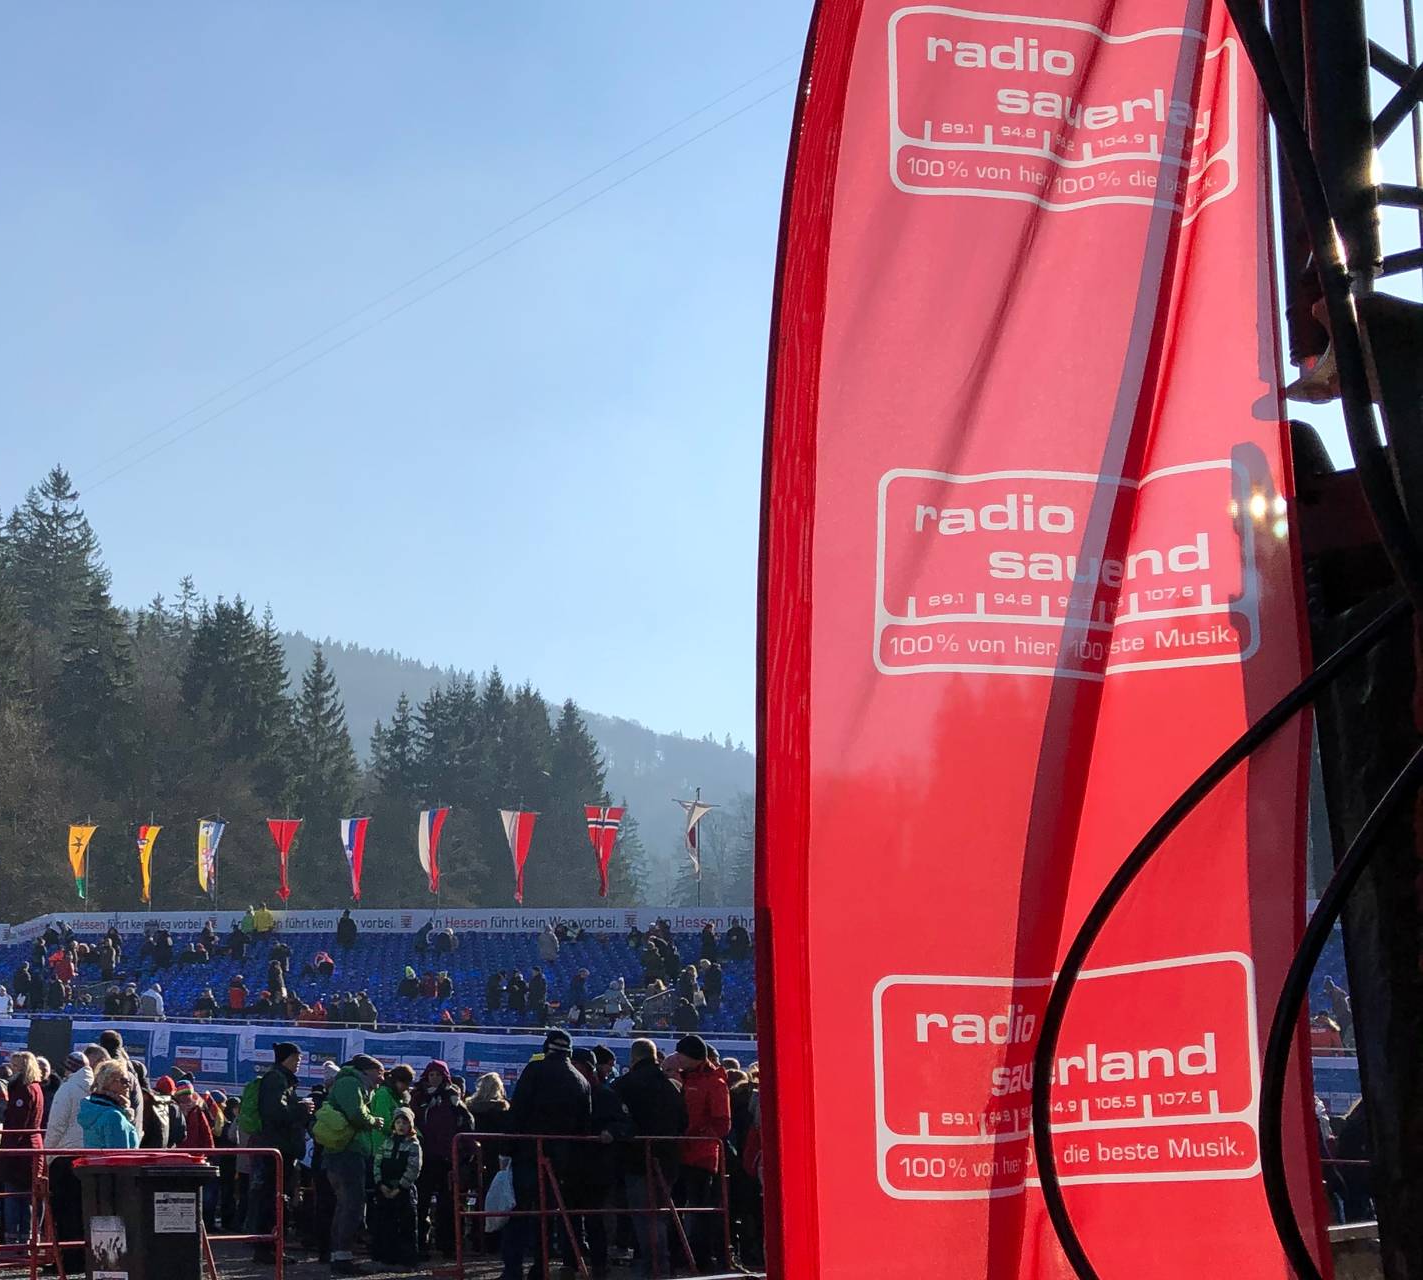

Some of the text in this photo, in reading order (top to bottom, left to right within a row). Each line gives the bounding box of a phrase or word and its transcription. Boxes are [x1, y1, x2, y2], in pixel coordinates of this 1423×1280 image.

[927, 36, 1075, 77] radio
[941, 122, 973, 135] 89.1
[1000, 126, 1037, 139] 94.8
[1097, 133, 1145, 149] 104.9
[976, 166, 1011, 180] von
[1128, 170, 1157, 188] die
[915, 493, 1074, 535] radio
[928, 592, 964, 607] 89.1
[994, 593, 1033, 606] 94.8
[1144, 585, 1194, 601] 107.6
[967, 639, 1005, 653] von
[1015, 635, 1059, 657] hier.
[1155, 625, 1238, 650] Musik.
[445, 916, 488, 929] Hessen
[489, 916, 519, 929] führt
[521, 916, 546, 929] kein
[915, 1004, 1036, 1045] radio
[992, 1032, 1217, 1096] saurland
[941, 1112, 974, 1125] 89.1
[1095, 1095, 1137, 1110] 106.5
[1157, 1091, 1203, 1106] 107.6
[972, 1161, 999, 1178] von
[1064, 1144, 1090, 1164] die
[1098, 1142, 1160, 1161] beste
[1168, 1136, 1245, 1160] Musik.
